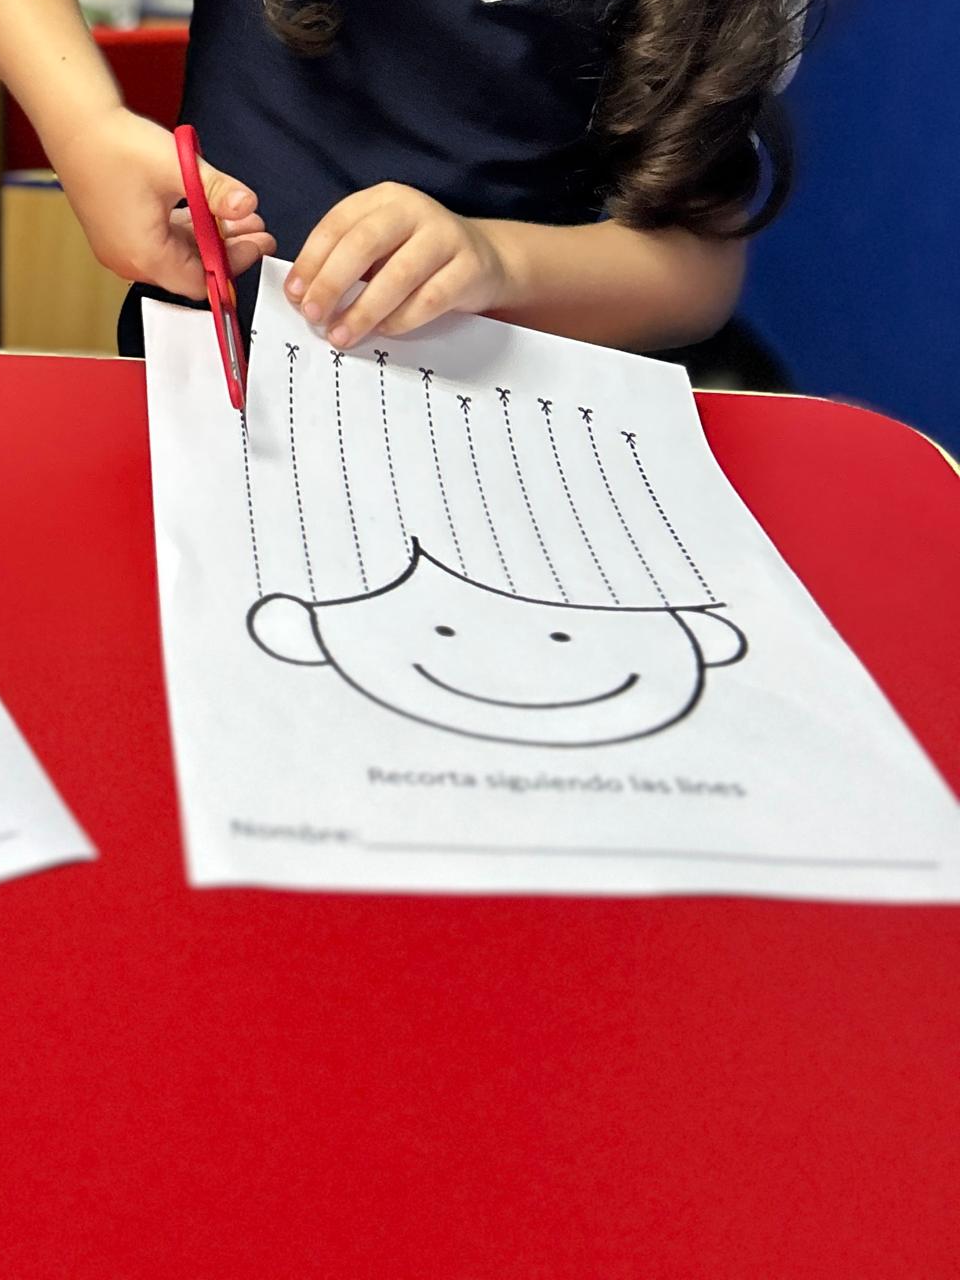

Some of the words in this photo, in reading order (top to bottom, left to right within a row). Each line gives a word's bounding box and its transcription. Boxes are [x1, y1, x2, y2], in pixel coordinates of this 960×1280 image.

[368, 766, 478, 788] Recorta
[485, 771, 624, 794] siguiendo
[628, 774, 674, 796] las
